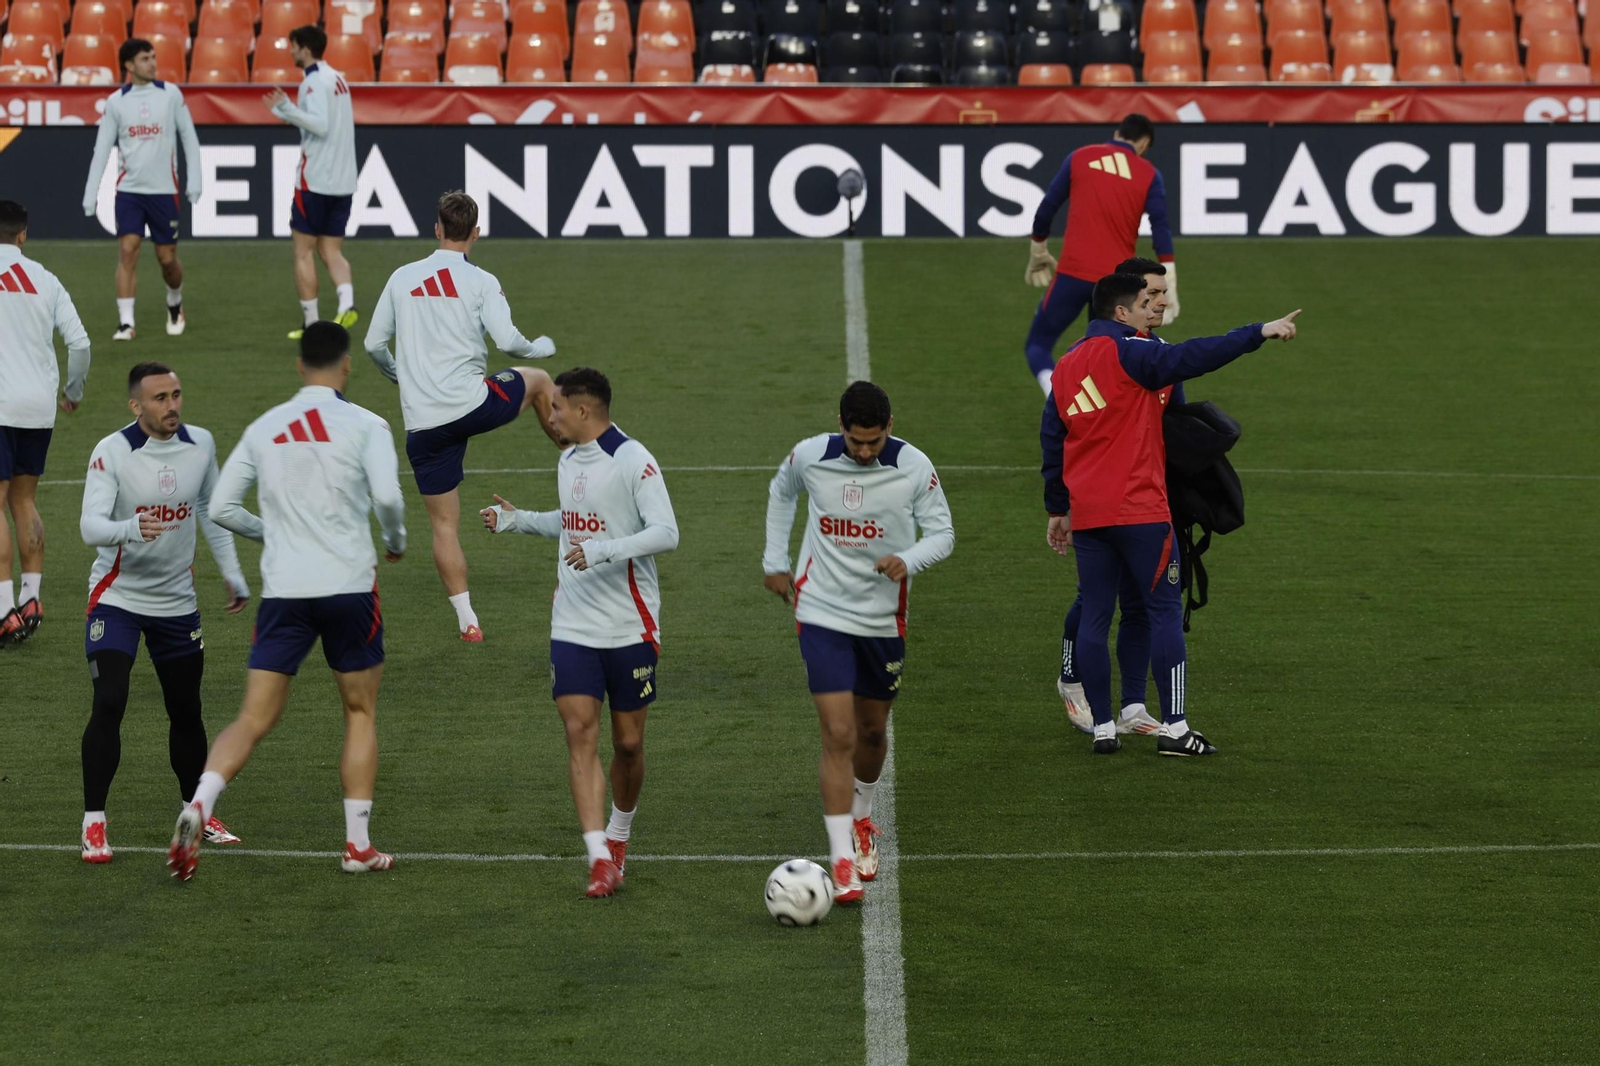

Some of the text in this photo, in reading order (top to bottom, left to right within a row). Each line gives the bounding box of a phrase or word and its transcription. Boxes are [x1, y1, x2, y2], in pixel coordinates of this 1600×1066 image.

[96, 142, 1600, 238] EA NATIONS EAGUE
[834, 538, 868, 548] Telecom
